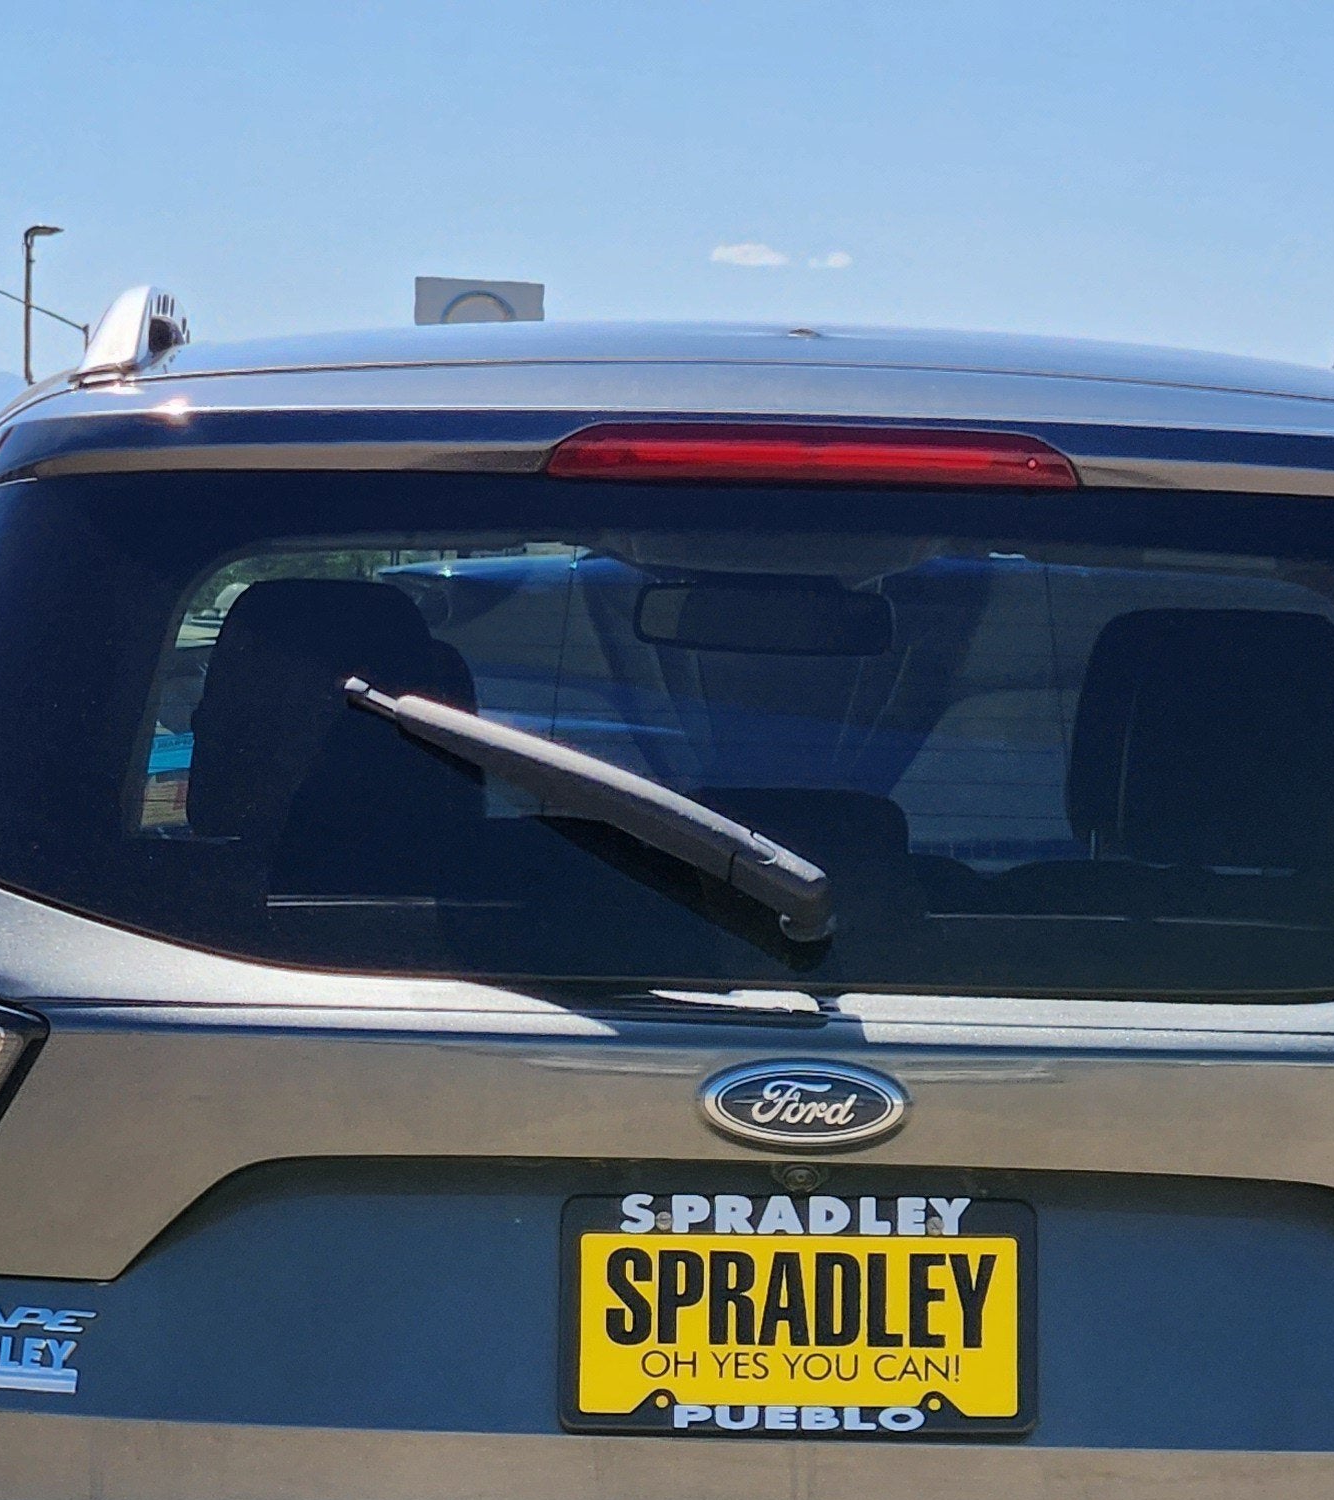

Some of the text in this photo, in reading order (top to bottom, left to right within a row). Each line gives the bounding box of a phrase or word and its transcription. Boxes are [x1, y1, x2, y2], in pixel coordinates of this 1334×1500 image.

[751, 1080, 857, 1126] Ford
[620, 1194, 971, 1236] SPRADLEY
[605, 1247, 997, 1348] SPRADLEY
[641, 1350, 961, 1382] OH YES YOU CAN!
[673, 1404, 925, 1431] PUEBLO
